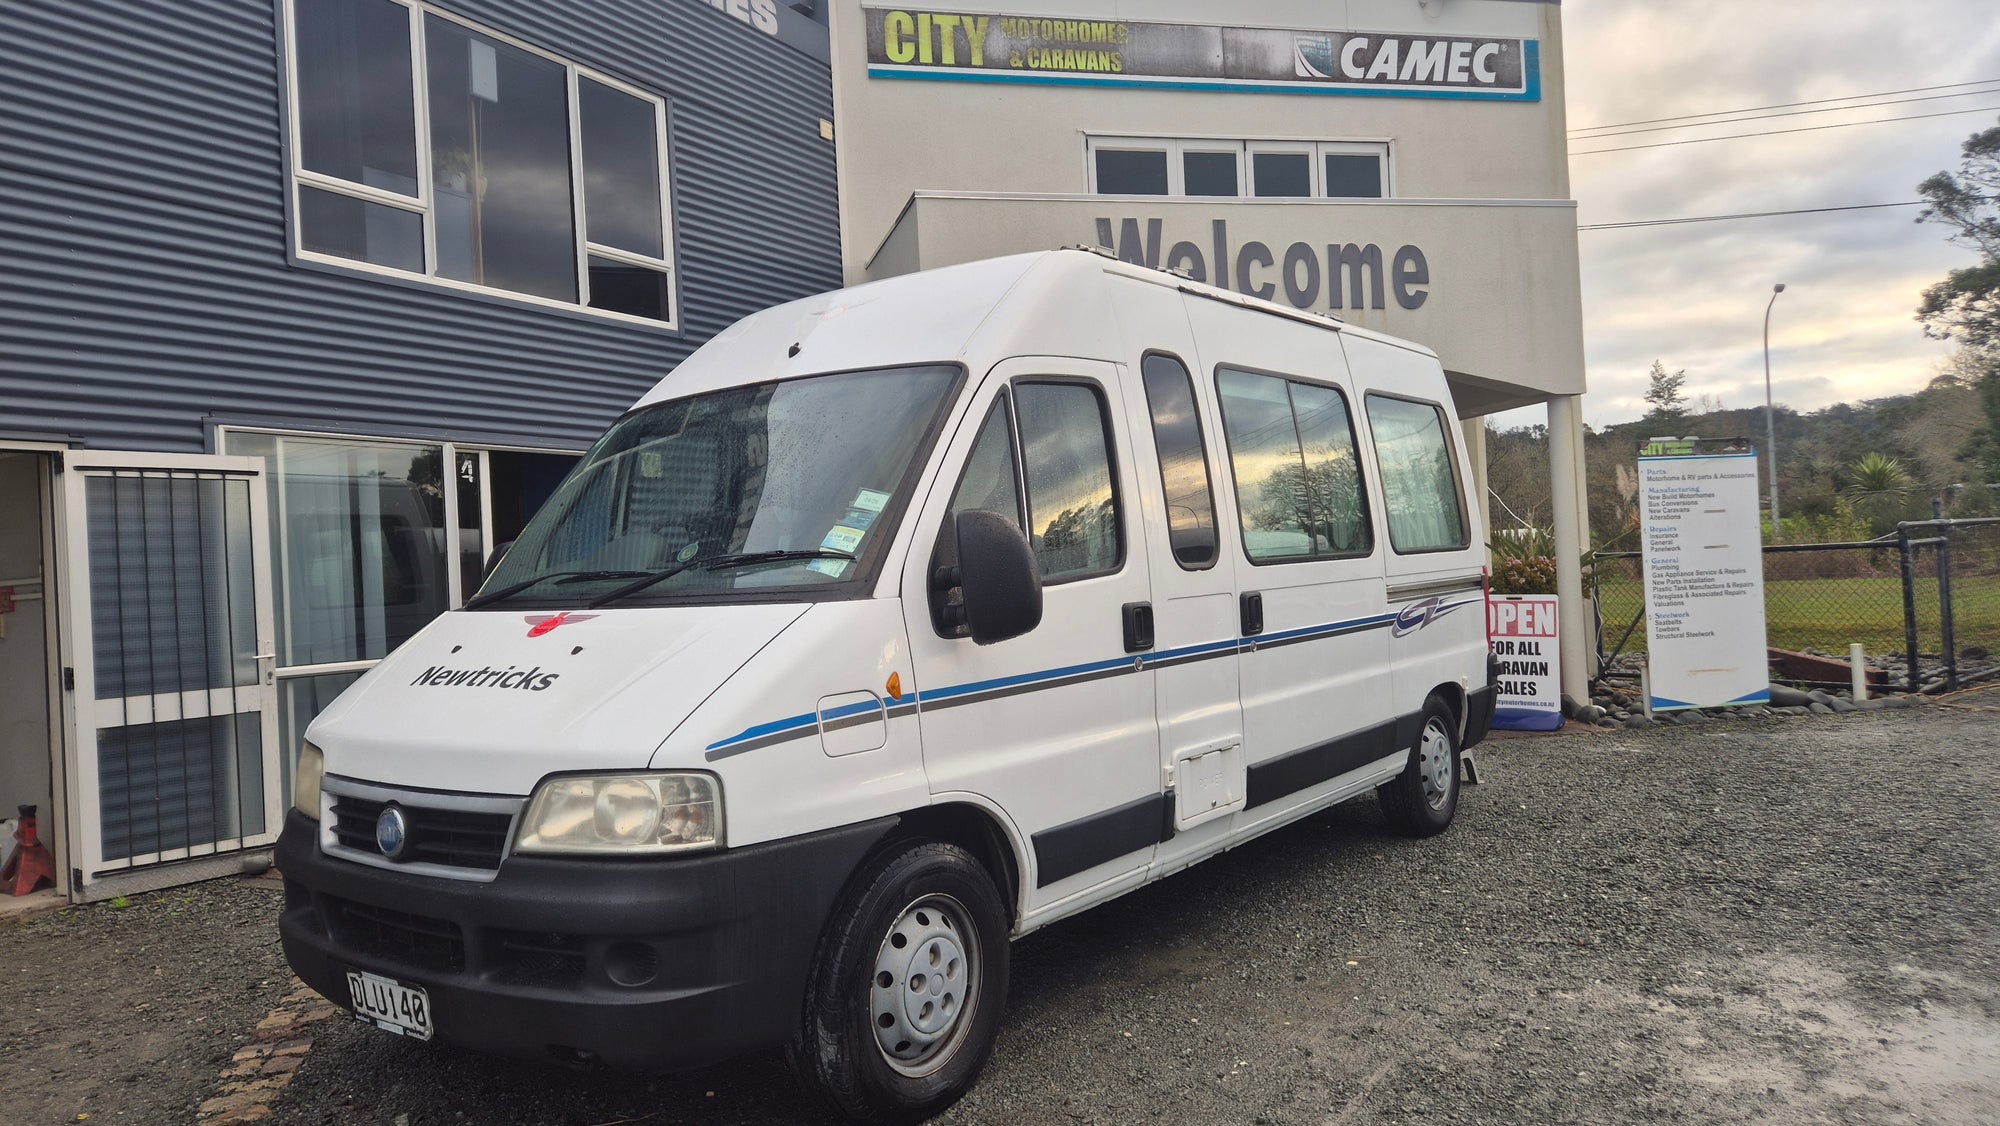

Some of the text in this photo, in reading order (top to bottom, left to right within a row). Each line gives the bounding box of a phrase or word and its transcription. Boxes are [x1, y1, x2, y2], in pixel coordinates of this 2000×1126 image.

[884, 10, 989, 66] CITY
[1001, 17, 1128, 44] MOTORHOMES
[1009, 48, 1123, 72] & CARAVANS
[1340, 37, 1500, 83] CAMEC
[461, 459, 474, 483] 4
[1648, 486, 1700, 494] Manufacturing
[1665, 571, 1694, 579] Appliance
[1689, 583, 1725, 591] Manufacture
[1653, 593, 1684, 601] Fibreglass
[1656, 632, 1685, 640] Structural
[1518, 641, 1541, 656] ALL
[1502, 661, 1548, 676] RAVAN
[410, 666, 560, 691] Newtricks
[1497, 681, 1537, 696] SALES
[349, 976, 427, 1027] DLU140
